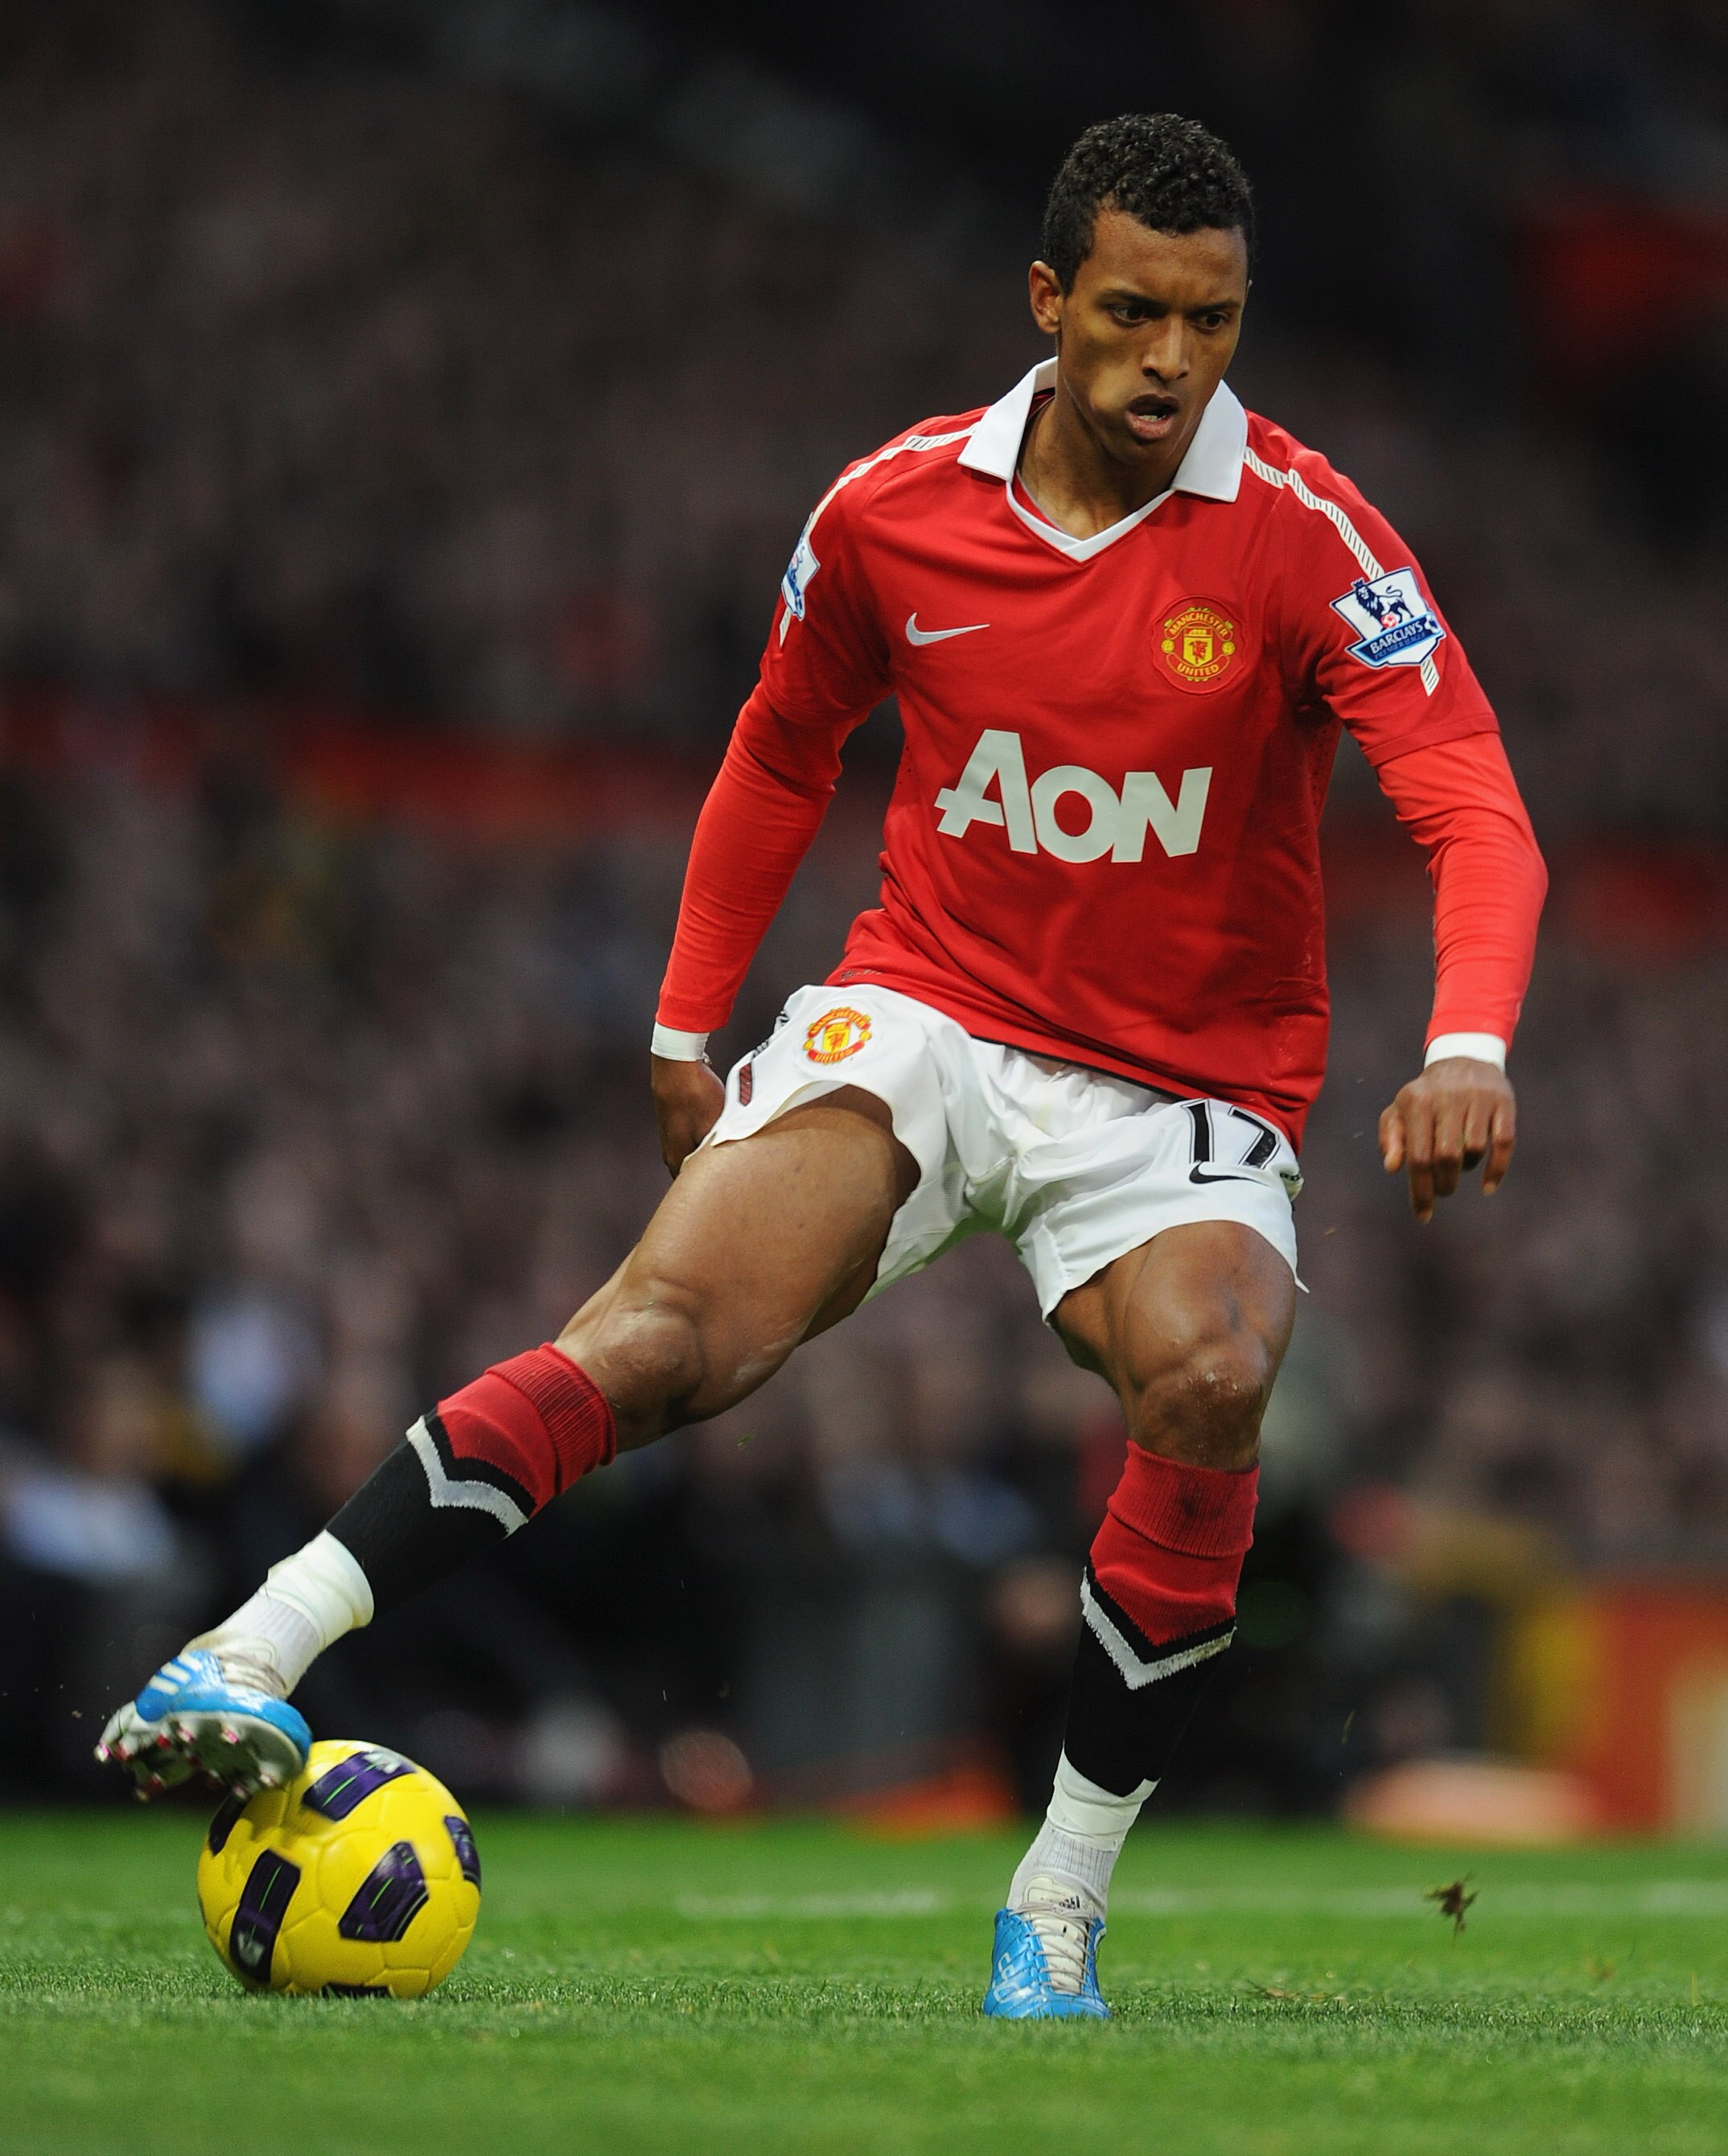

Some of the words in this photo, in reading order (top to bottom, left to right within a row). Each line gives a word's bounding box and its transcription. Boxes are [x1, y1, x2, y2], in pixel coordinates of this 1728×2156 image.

[1169, 611, 1228, 636] MANCHESTER
[1370, 620, 1424, 654] BARCLAYS
[1177, 664, 1220, 676] UNITED
[934, 729, 1213, 863] AON
[1181, 1098, 1281, 1170] 17
